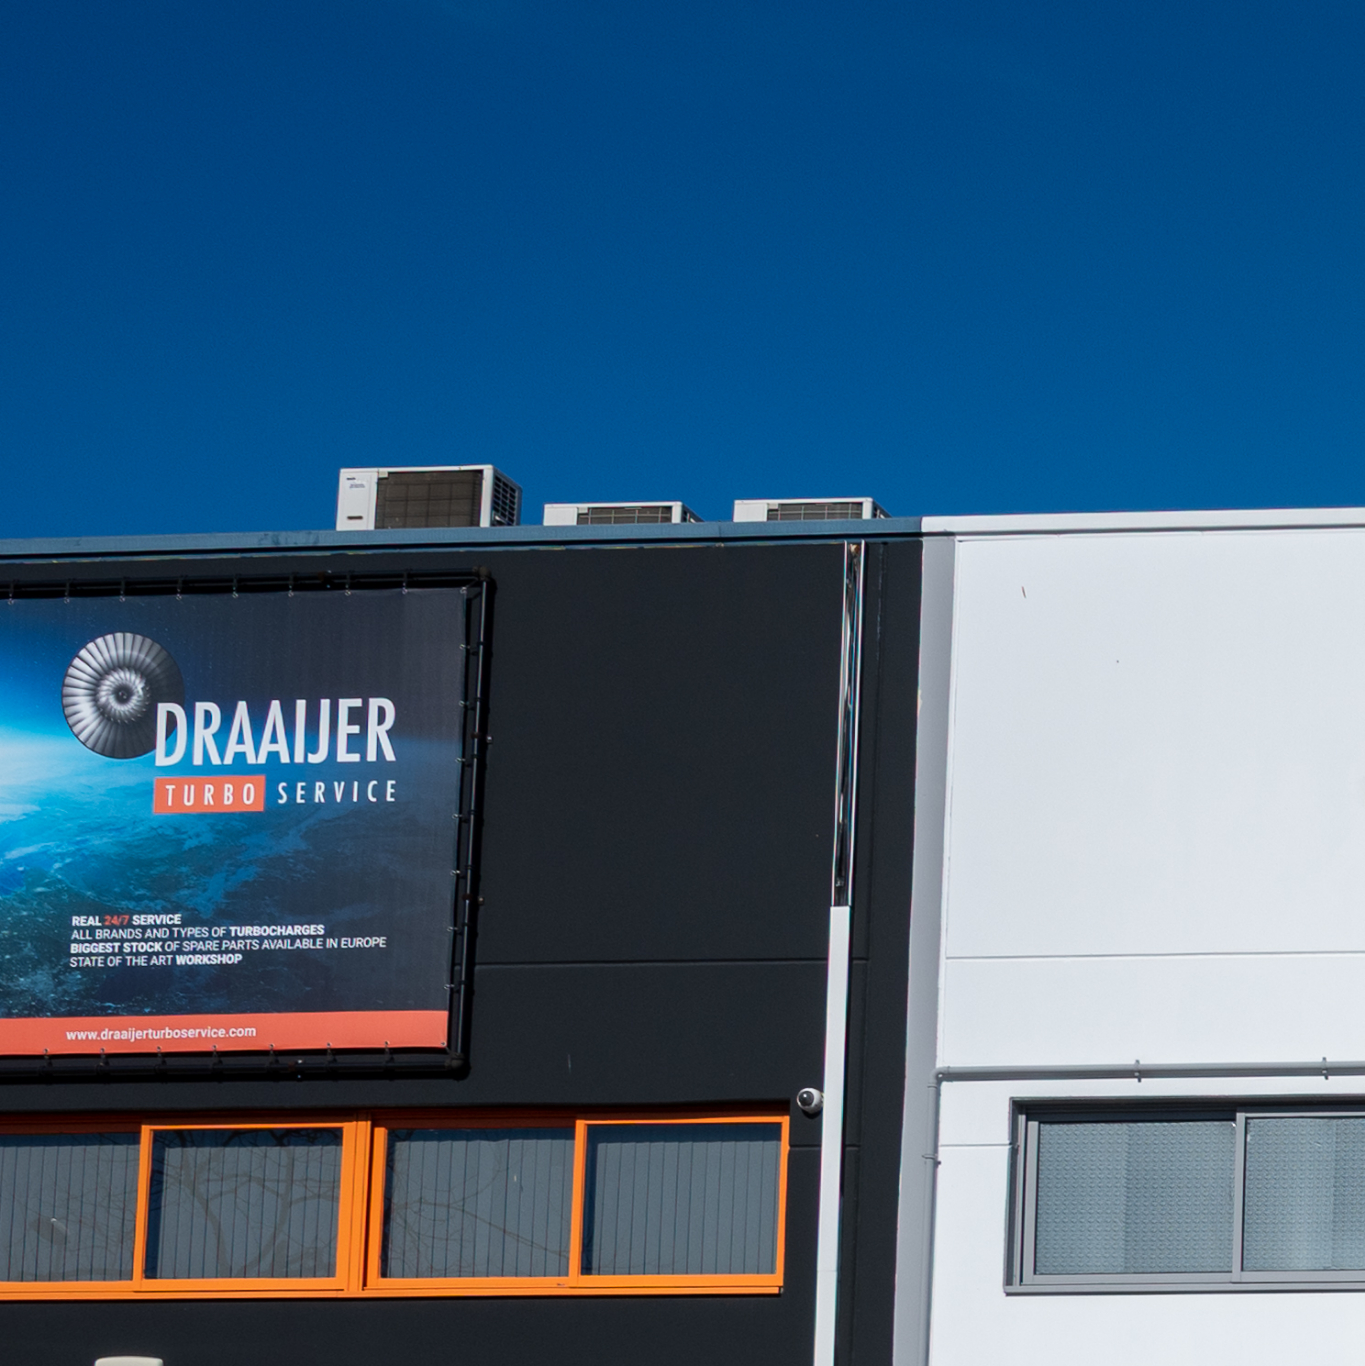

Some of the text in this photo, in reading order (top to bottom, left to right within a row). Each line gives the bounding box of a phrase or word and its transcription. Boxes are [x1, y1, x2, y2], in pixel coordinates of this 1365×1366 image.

[154, 697, 397, 767] DRAAIJER
[165, 780, 397, 807] TURBO SERVICE
[72, 914, 182, 927] REAL 24/7 SERVICE
[71, 924, 325, 940] ALL BRANDS AND TYPES OF TURBOCHARGES
[70, 937, 387, 954] BIGGEST STOCK OF SPARE PARTS AVAILABLE IN EUROPE
[69, 953, 243, 967] STATE OF THE ART WORKSHOP
[66, 1026, 257, 1042] www.draaijerturboservice.com
